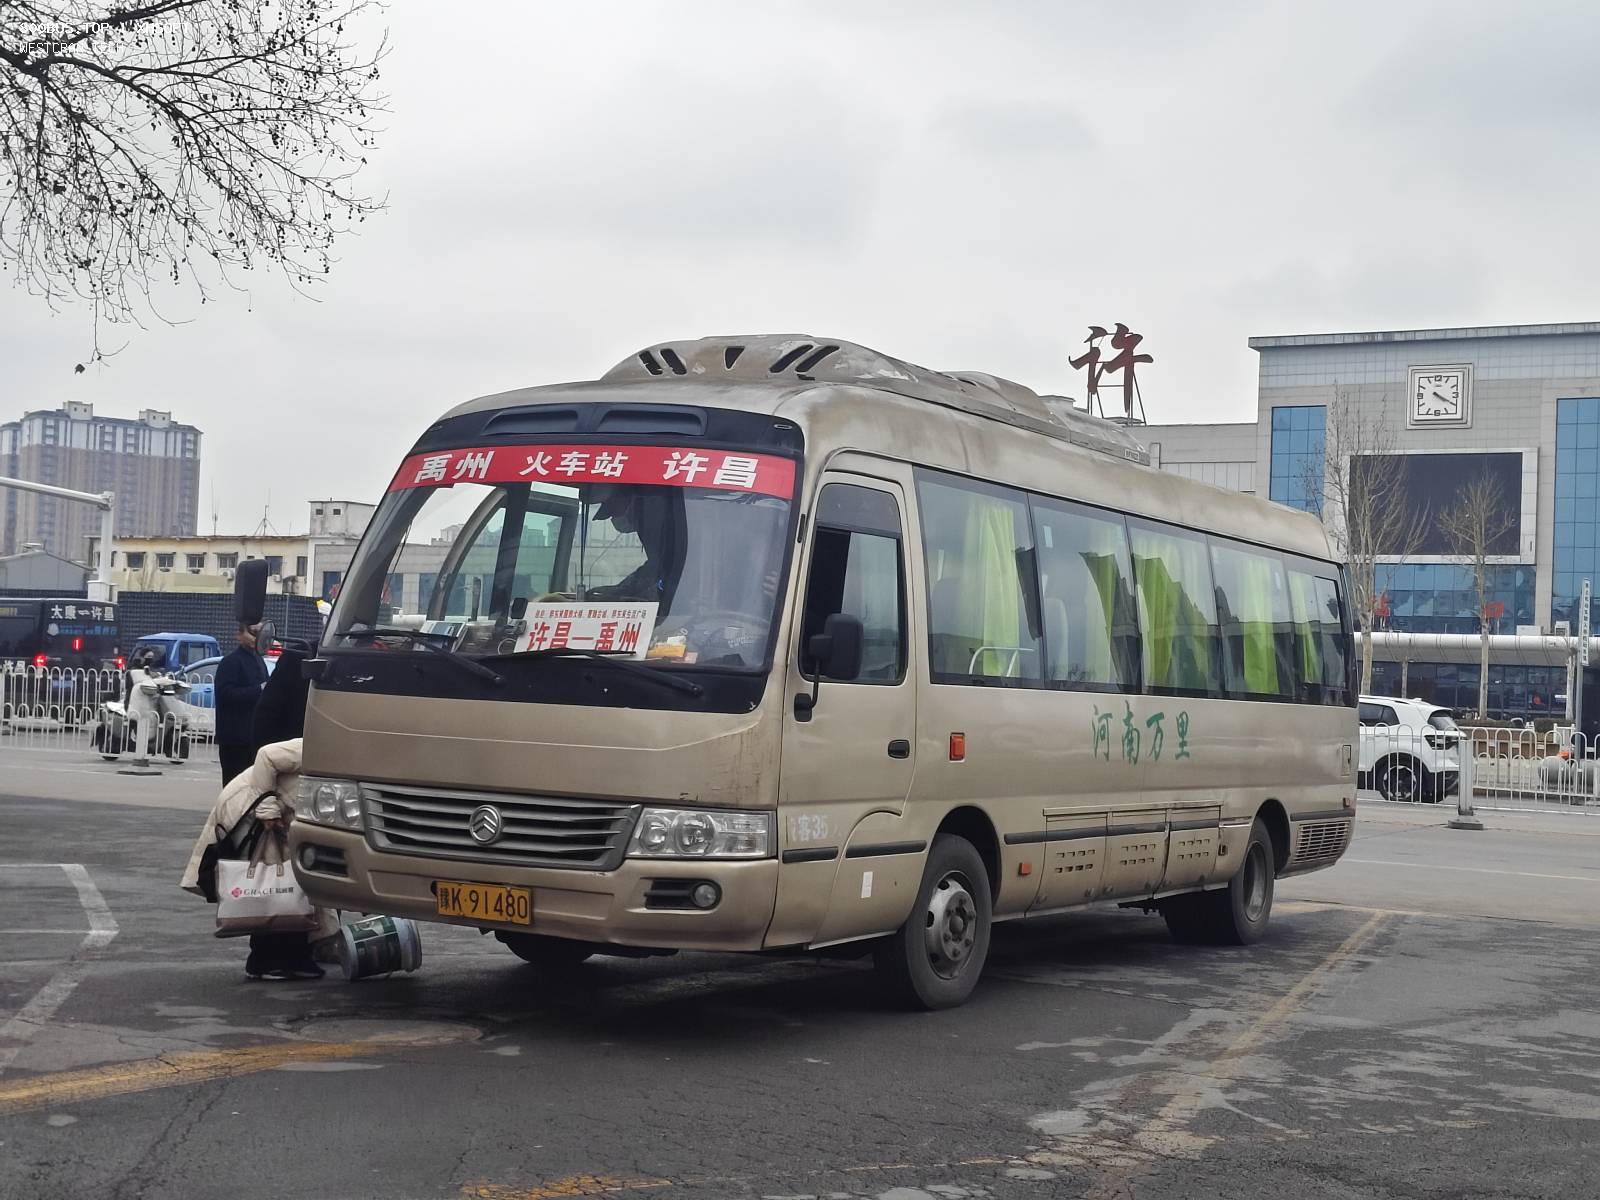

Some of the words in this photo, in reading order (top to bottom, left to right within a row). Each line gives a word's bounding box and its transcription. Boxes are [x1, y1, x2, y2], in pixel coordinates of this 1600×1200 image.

[1068, 323, 1153, 413] 许
[414, 450, 496, 483] 禹州
[519, 451, 629, 477] 火车站
[662, 451, 759, 488] 许昌
[1091, 699, 1190, 765] 河南万里
